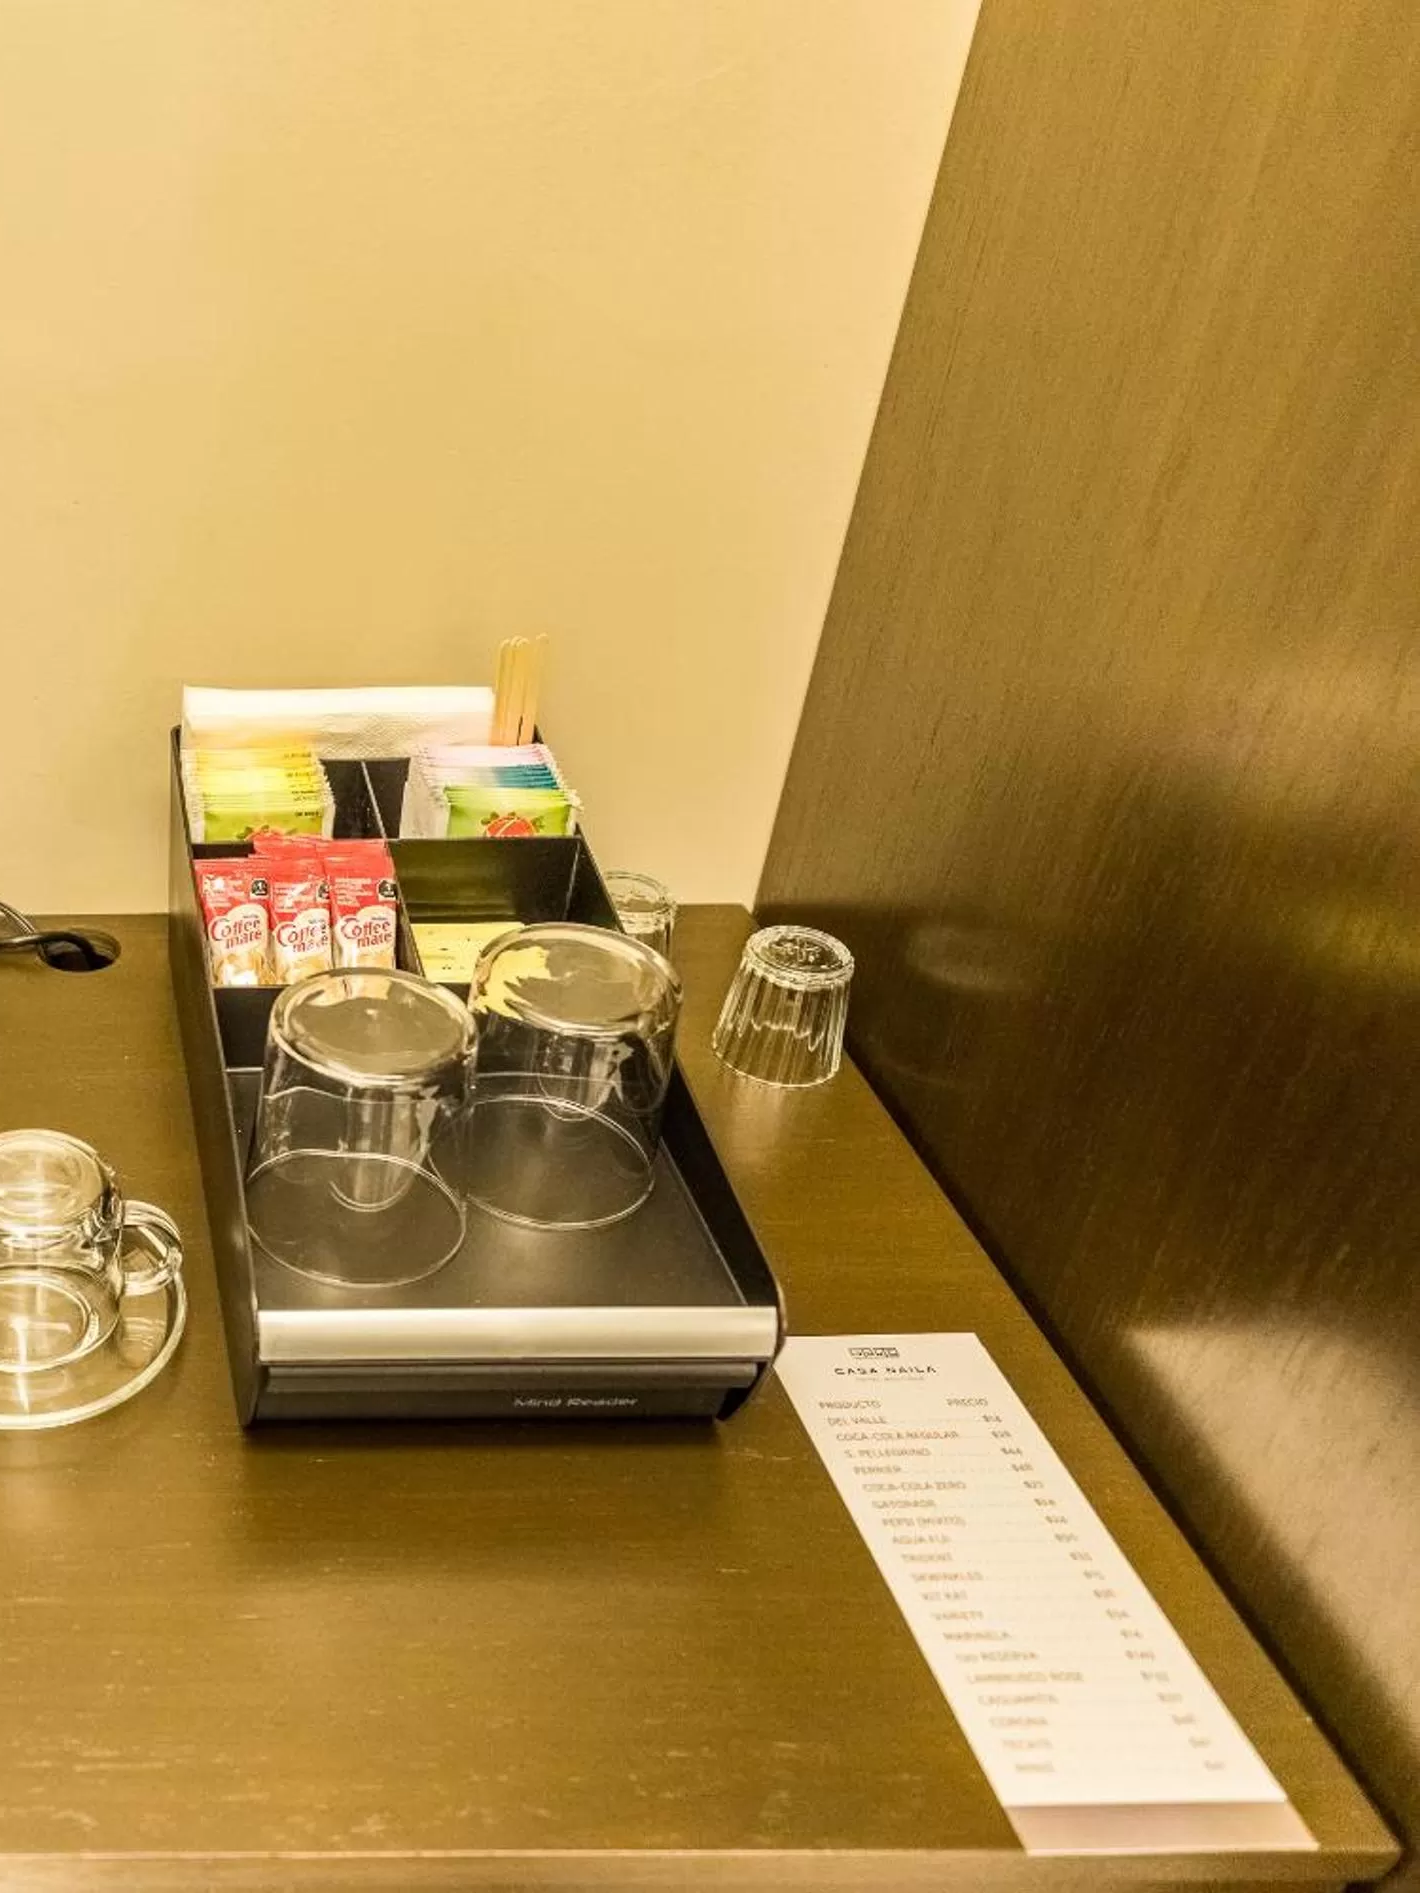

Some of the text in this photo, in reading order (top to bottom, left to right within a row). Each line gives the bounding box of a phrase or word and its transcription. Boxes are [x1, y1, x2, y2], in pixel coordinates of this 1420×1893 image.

[211, 918, 261, 941] Coffee
[341, 917, 391, 940] Coffee
[225, 930, 263, 949] mate
[357, 931, 393, 949] mate
[834, 1367, 878, 1376] CASA
[818, 1398, 989, 1409] PRODUCTO PRECIO
